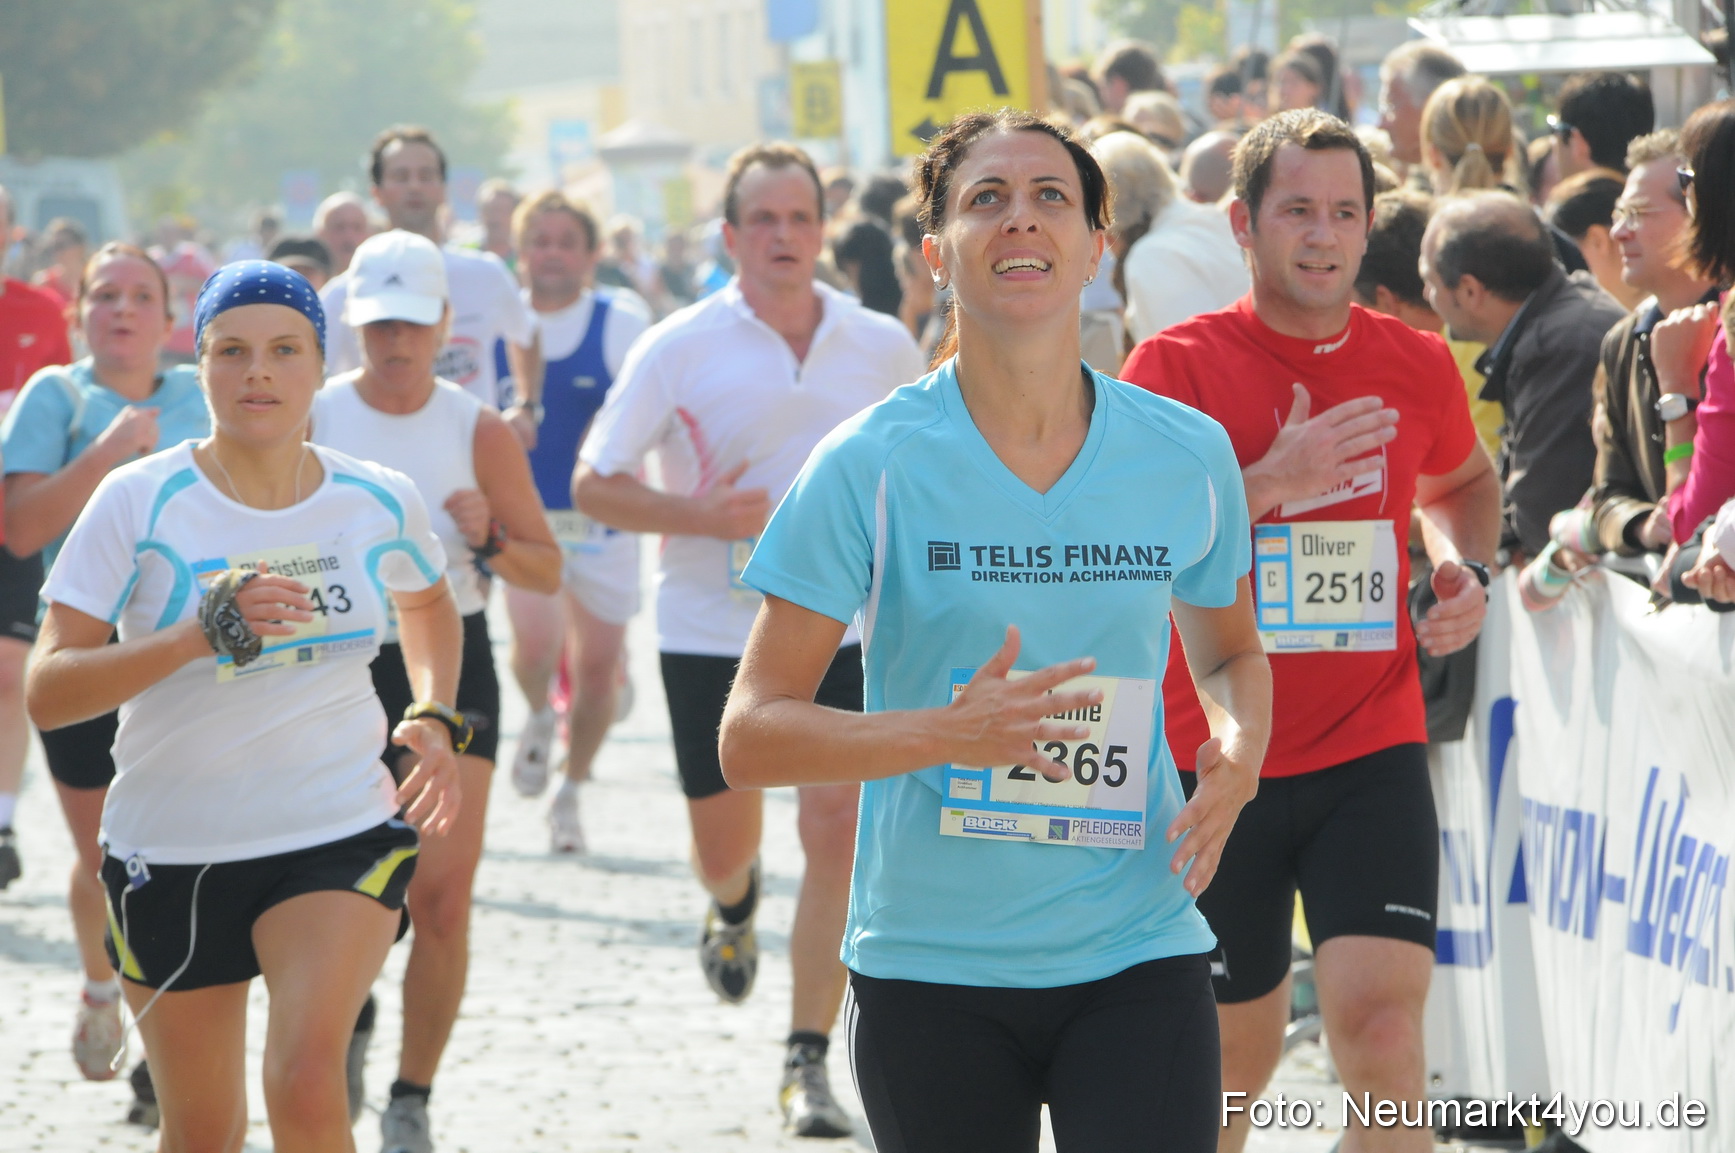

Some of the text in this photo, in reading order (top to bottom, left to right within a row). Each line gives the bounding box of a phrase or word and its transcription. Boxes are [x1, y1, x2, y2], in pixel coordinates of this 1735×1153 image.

[925, 0, 1011, 98] A
[1301, 534, 1356, 556] Oliver
[969, 544, 1172, 568] TELIS FINANZ
[971, 569, 1173, 584] DIREKTION ACHHAMMER
[1267, 570, 1277, 588] C
[1305, 571, 1385, 604] 2518
[963, 815, 1018, 831] BOCK
[1072, 820, 1142, 837] PFLEIDERER
